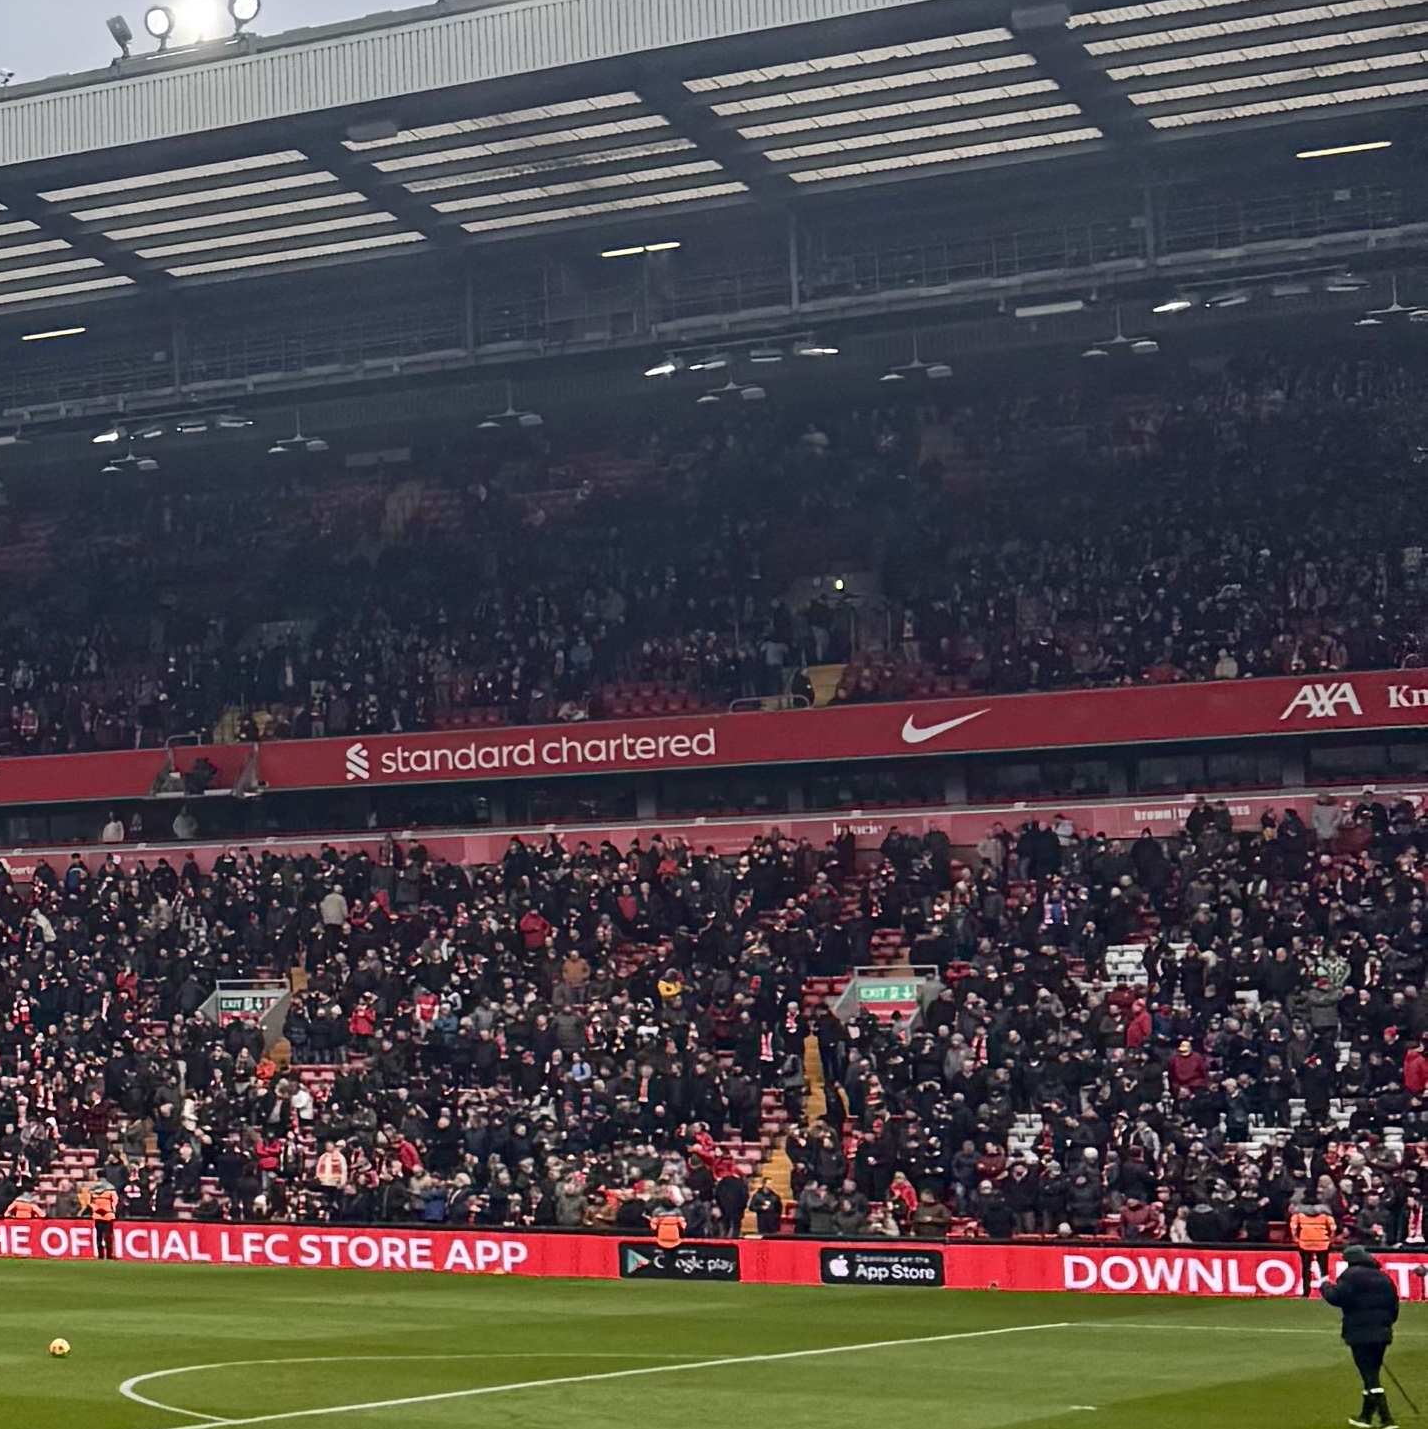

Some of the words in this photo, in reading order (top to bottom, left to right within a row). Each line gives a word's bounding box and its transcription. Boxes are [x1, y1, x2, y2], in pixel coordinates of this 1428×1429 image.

[1279, 682, 1363, 720] AXA
[381, 738, 536, 774] standard
[541, 727, 716, 764] chartered
[40, 1226, 212, 1262] OFICIAL
[220, 1231, 290, 1264] LFC
[299, 1234, 434, 1270] STORE
[443, 1239, 528, 1274] APP
[855, 1263, 890, 1281] App
[891, 1263, 936, 1280] Store
[1062, 1254, 1348, 1296] DOWNLO
